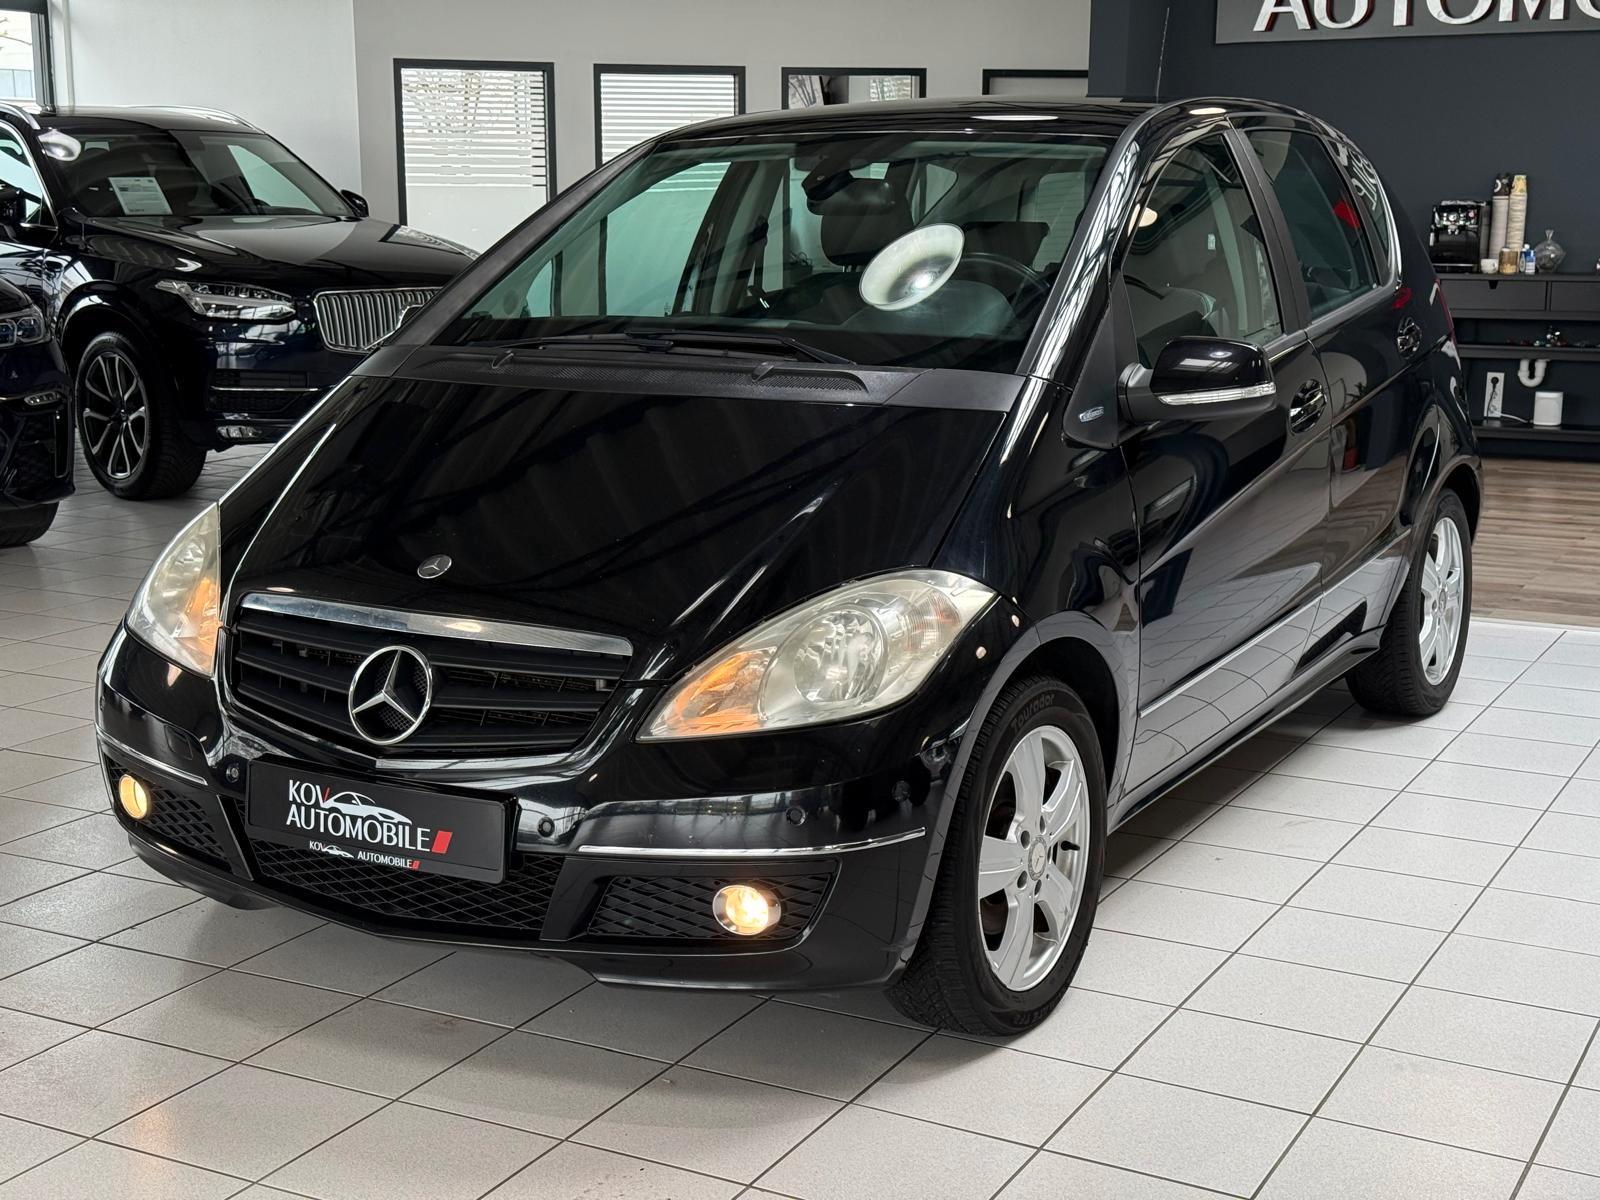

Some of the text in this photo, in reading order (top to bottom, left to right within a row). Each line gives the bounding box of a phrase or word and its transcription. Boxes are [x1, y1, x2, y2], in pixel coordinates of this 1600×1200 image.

[289, 779, 331, 808] KOV
[286, 804, 431, 852] AUTOMOBILE
[357, 851, 414, 869] AUTOMOBILE
